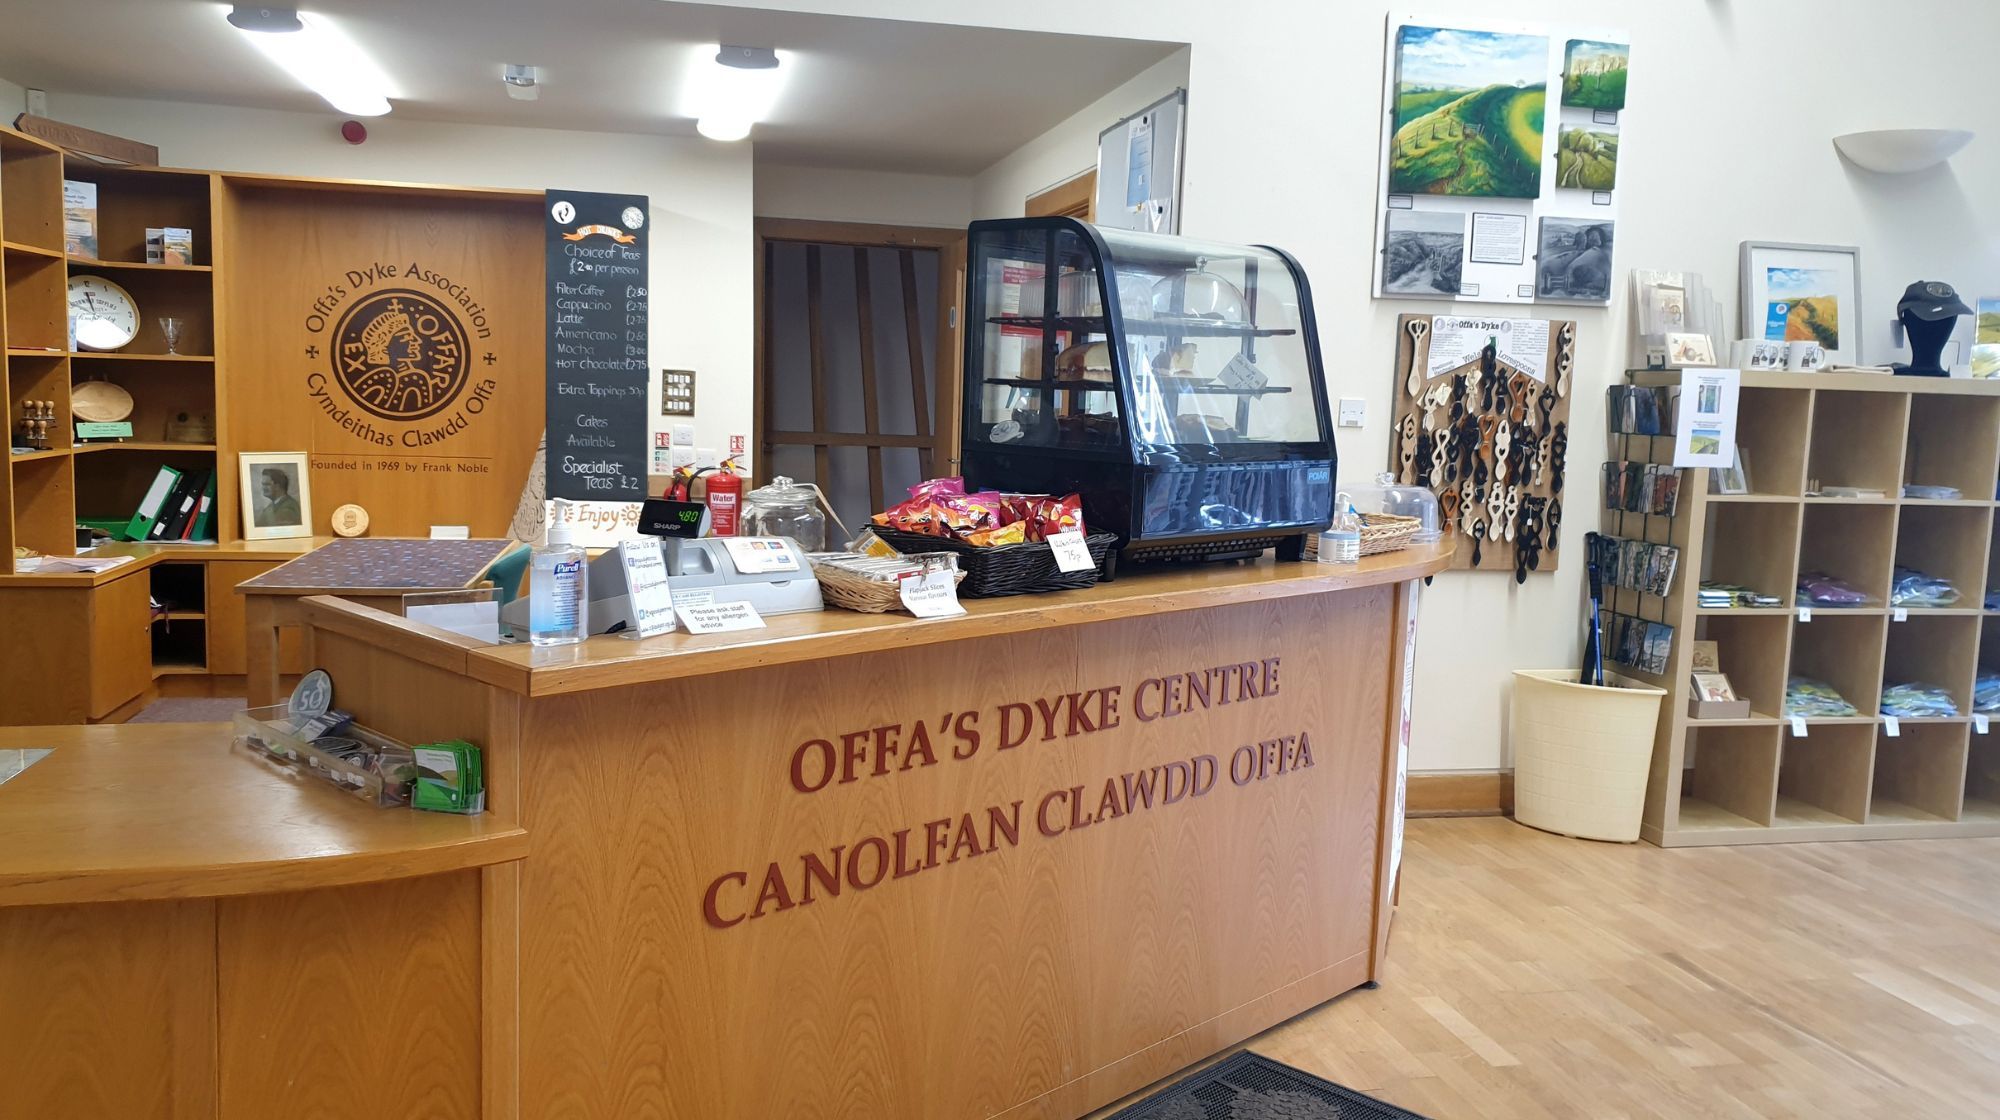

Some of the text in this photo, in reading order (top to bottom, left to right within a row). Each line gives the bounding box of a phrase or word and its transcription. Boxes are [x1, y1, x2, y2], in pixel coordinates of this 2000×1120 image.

[564, 243, 641, 260] Choice of Teas
[595, 264, 610, 276] per
[611, 265, 640, 278] person
[556, 282, 577, 295] Filter
[578, 283, 605, 296] Coffee
[305, 262, 491, 339] Offa's Dyke Association
[556, 312, 584, 324] Latte
[1458, 320, 1500, 331] Offa's Dyke
[555, 326, 617, 341] Americano
[557, 343, 595, 355] Mocha
[556, 359, 578, 369] HOT
[580, 356, 626, 370] chocolate
[1462, 351, 1482, 363] Wels
[1497, 350, 1536, 375] Lovespoons
[557, 383, 586, 395] Extra
[587, 383, 626, 398] Toppings
[307, 373, 497, 448] Cymdeithas Clawdd Offa
[576, 414, 609, 428] Cakes
[567, 433, 616, 448] Available
[311, 459, 489, 473] Founded in 1969 by Frank Noble
[562, 455, 624, 476] Specialist
[583, 475, 639, 490] Teas £2
[712, 494, 734, 502] Water
[577, 503, 620, 532] Enjoy
[653, 522, 681, 531] SHARP
[789, 656, 1282, 795] OFFA'S DYKE CENTRE
[701, 731, 1315, 930] CANOLFAN CLAWDD OFFA
